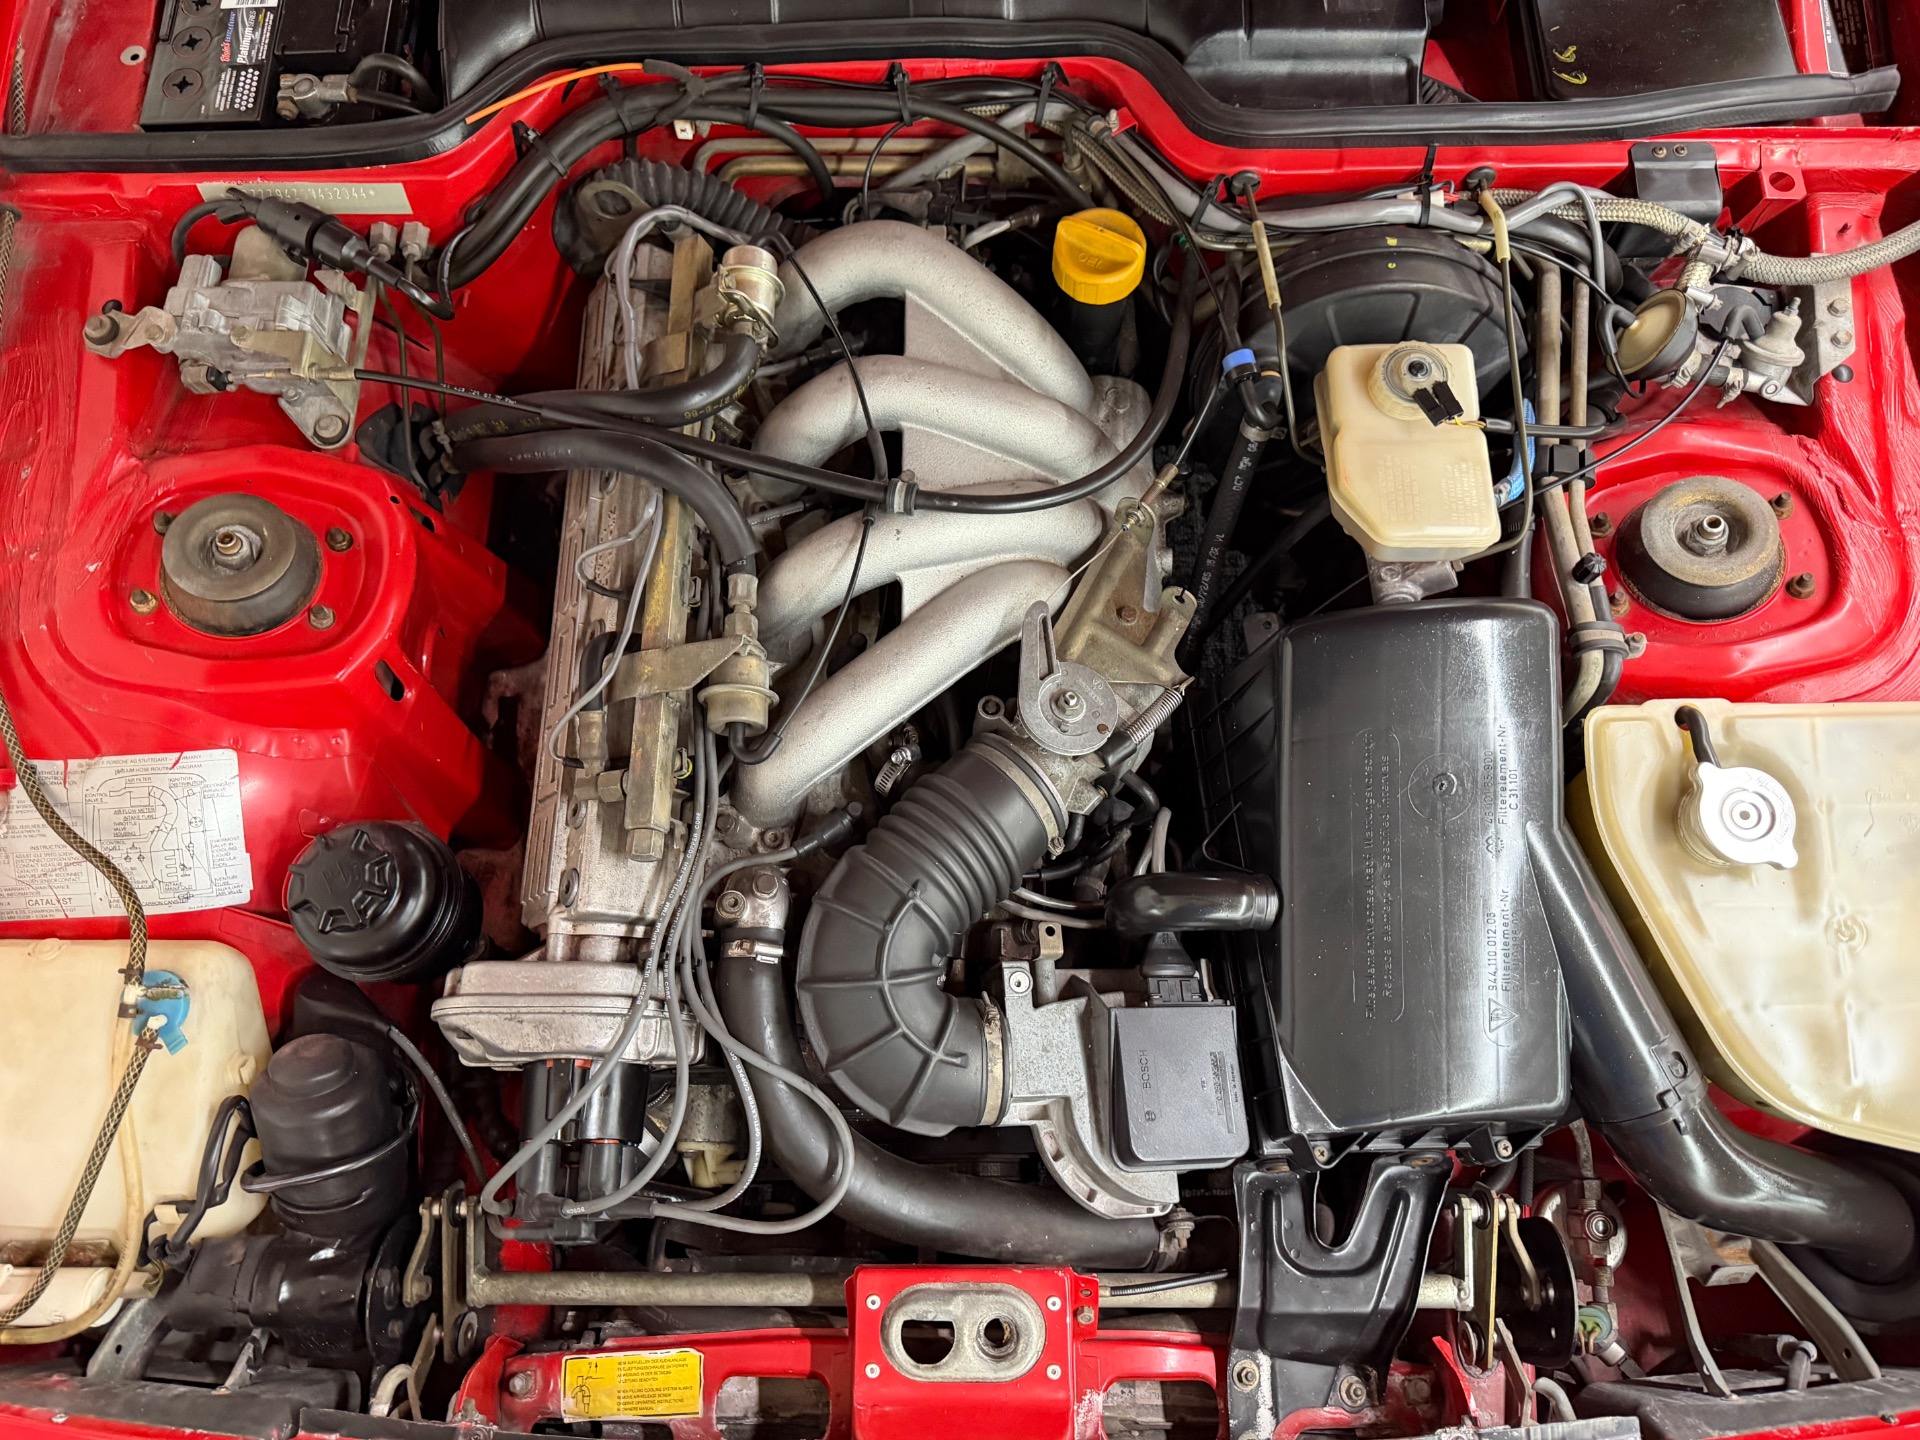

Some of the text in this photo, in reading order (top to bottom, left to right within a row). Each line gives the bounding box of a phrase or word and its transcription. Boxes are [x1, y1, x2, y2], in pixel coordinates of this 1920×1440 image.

[237, 10, 257, 64] Platinum SERIES
[1077, 252, 1103, 269] OEL
[1508, 768, 1518, 811] C 31 101
[644, 957, 653, 979] ULTRA
[661, 901, 671, 917] 7MM
[668, 861, 689, 900] OPTI-LAYER
[686, 832, 699, 859] COPPER
[694, 811, 702, 830] CORE
[1500, 884, 1511, 992] Filterelement-Nr.
[1381, 948, 1395, 998] Replace
[735, 1063, 750, 1093] COPPER
[1138, 1049, 1152, 1090] BOSCH
[747, 1094, 761, 1138] OPTI-LAYER
